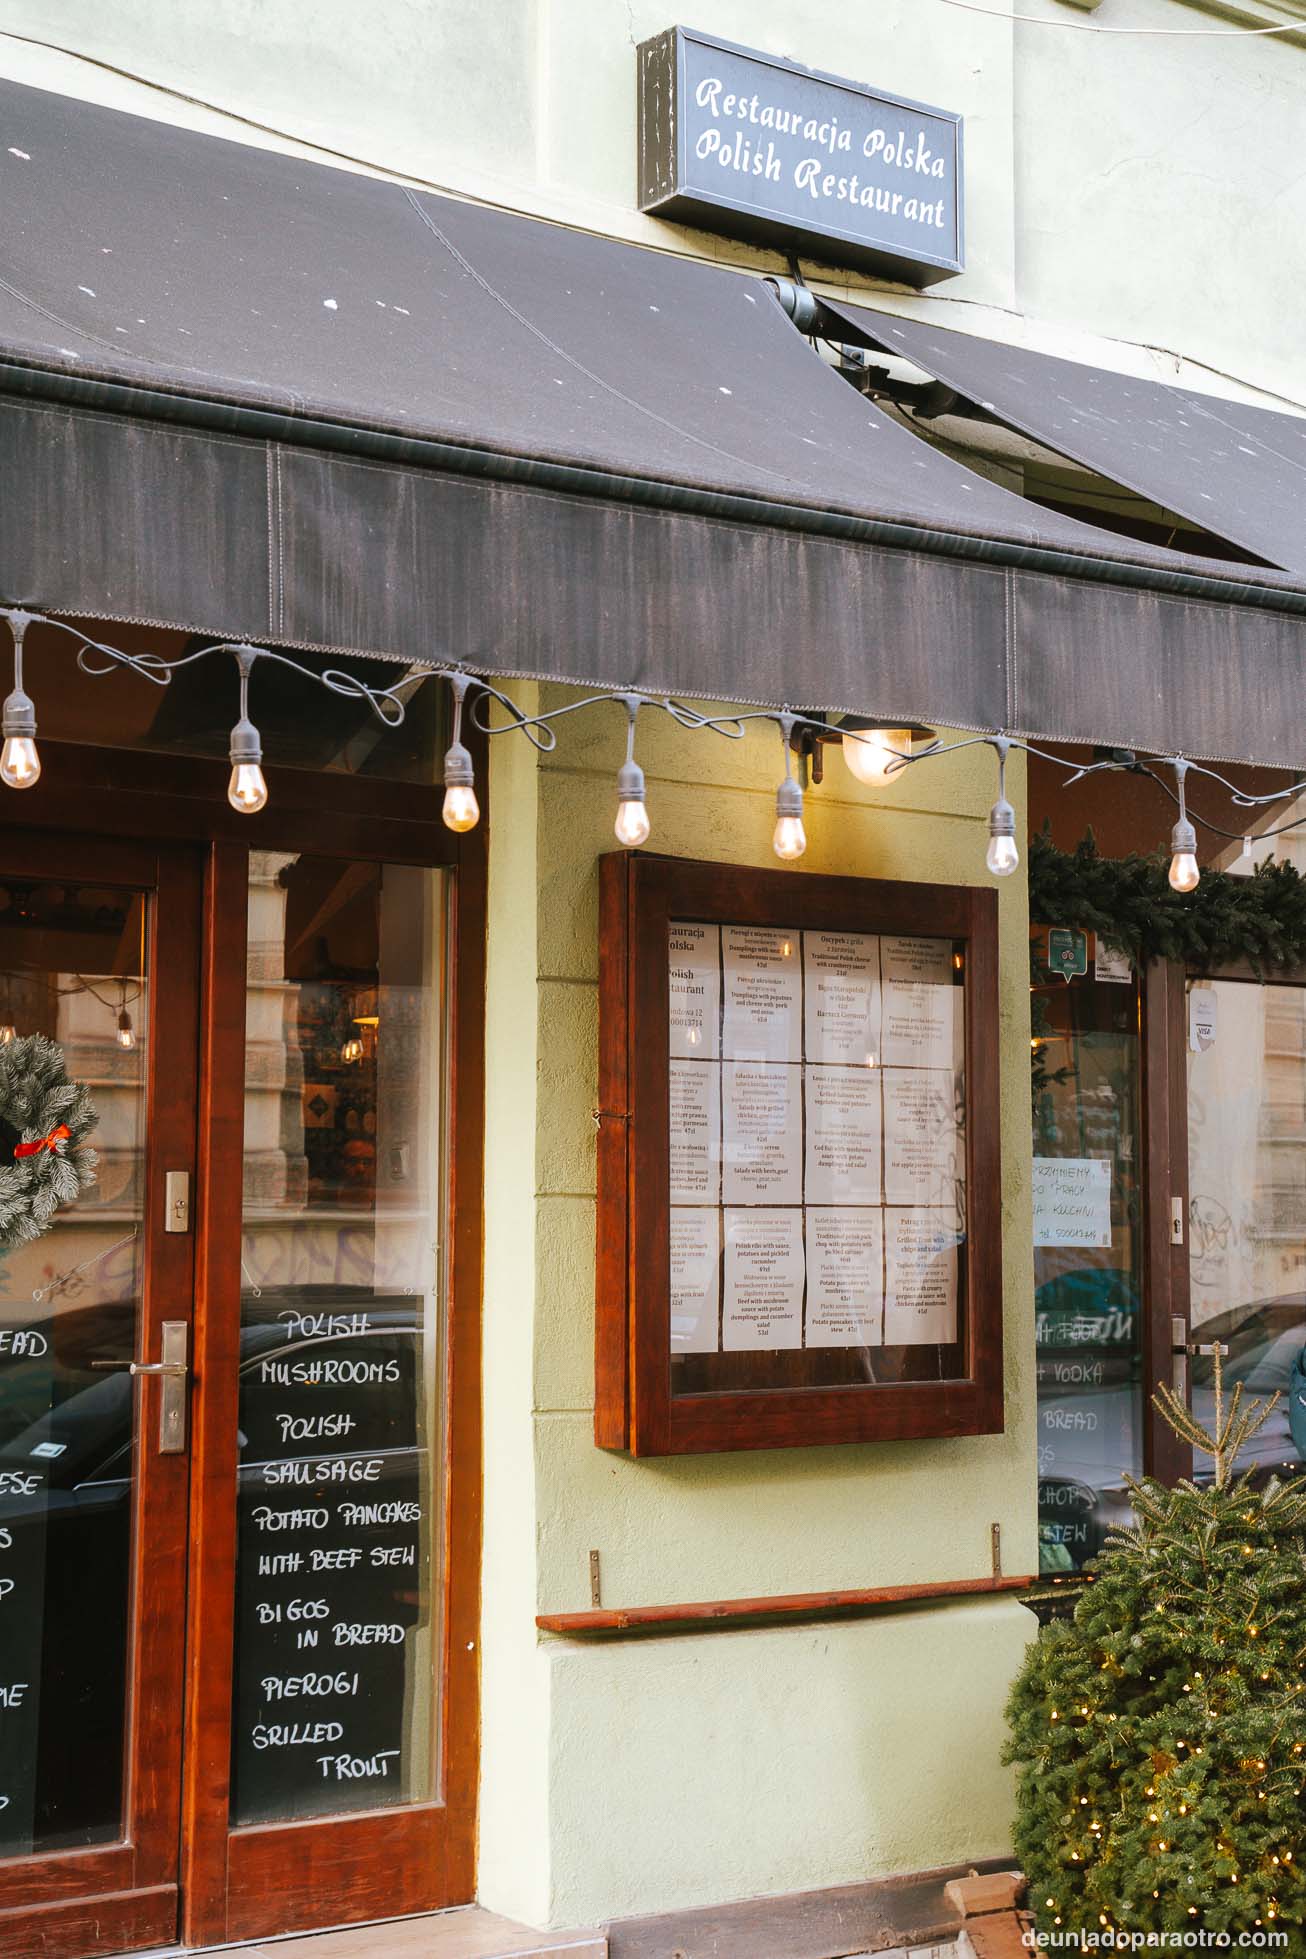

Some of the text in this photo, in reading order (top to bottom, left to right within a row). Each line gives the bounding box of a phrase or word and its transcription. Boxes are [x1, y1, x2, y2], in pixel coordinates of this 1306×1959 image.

[695, 78, 945, 179] Restauracja Polska
[695, 128, 945, 228] Polish Restaurant
[670, 928, 704, 939] auracja
[668, 968, 694, 980] olish
[277, 1310, 372, 1340] POLISH
[261, 1359, 400, 1387] MUSHROOMS
[1054, 1363, 1103, 1384] VODKA
[276, 1413, 356, 1443] POLISH
[1043, 1409, 1098, 1431] BREAD
[263, 1459, 385, 1485] SAUSAGE
[252, 1501, 422, 1532] POTATO PANCAKES
[1043, 1522, 1088, 1543] STEW
[258, 1545, 416, 1576] WITH BEEF STEW
[297, 1623, 406, 1649] IN BREAD
[260, 1672, 359, 1702] PIEROGI
[251, 1722, 344, 1751] GRILLED
[316, 1750, 402, 1782] TROUT
